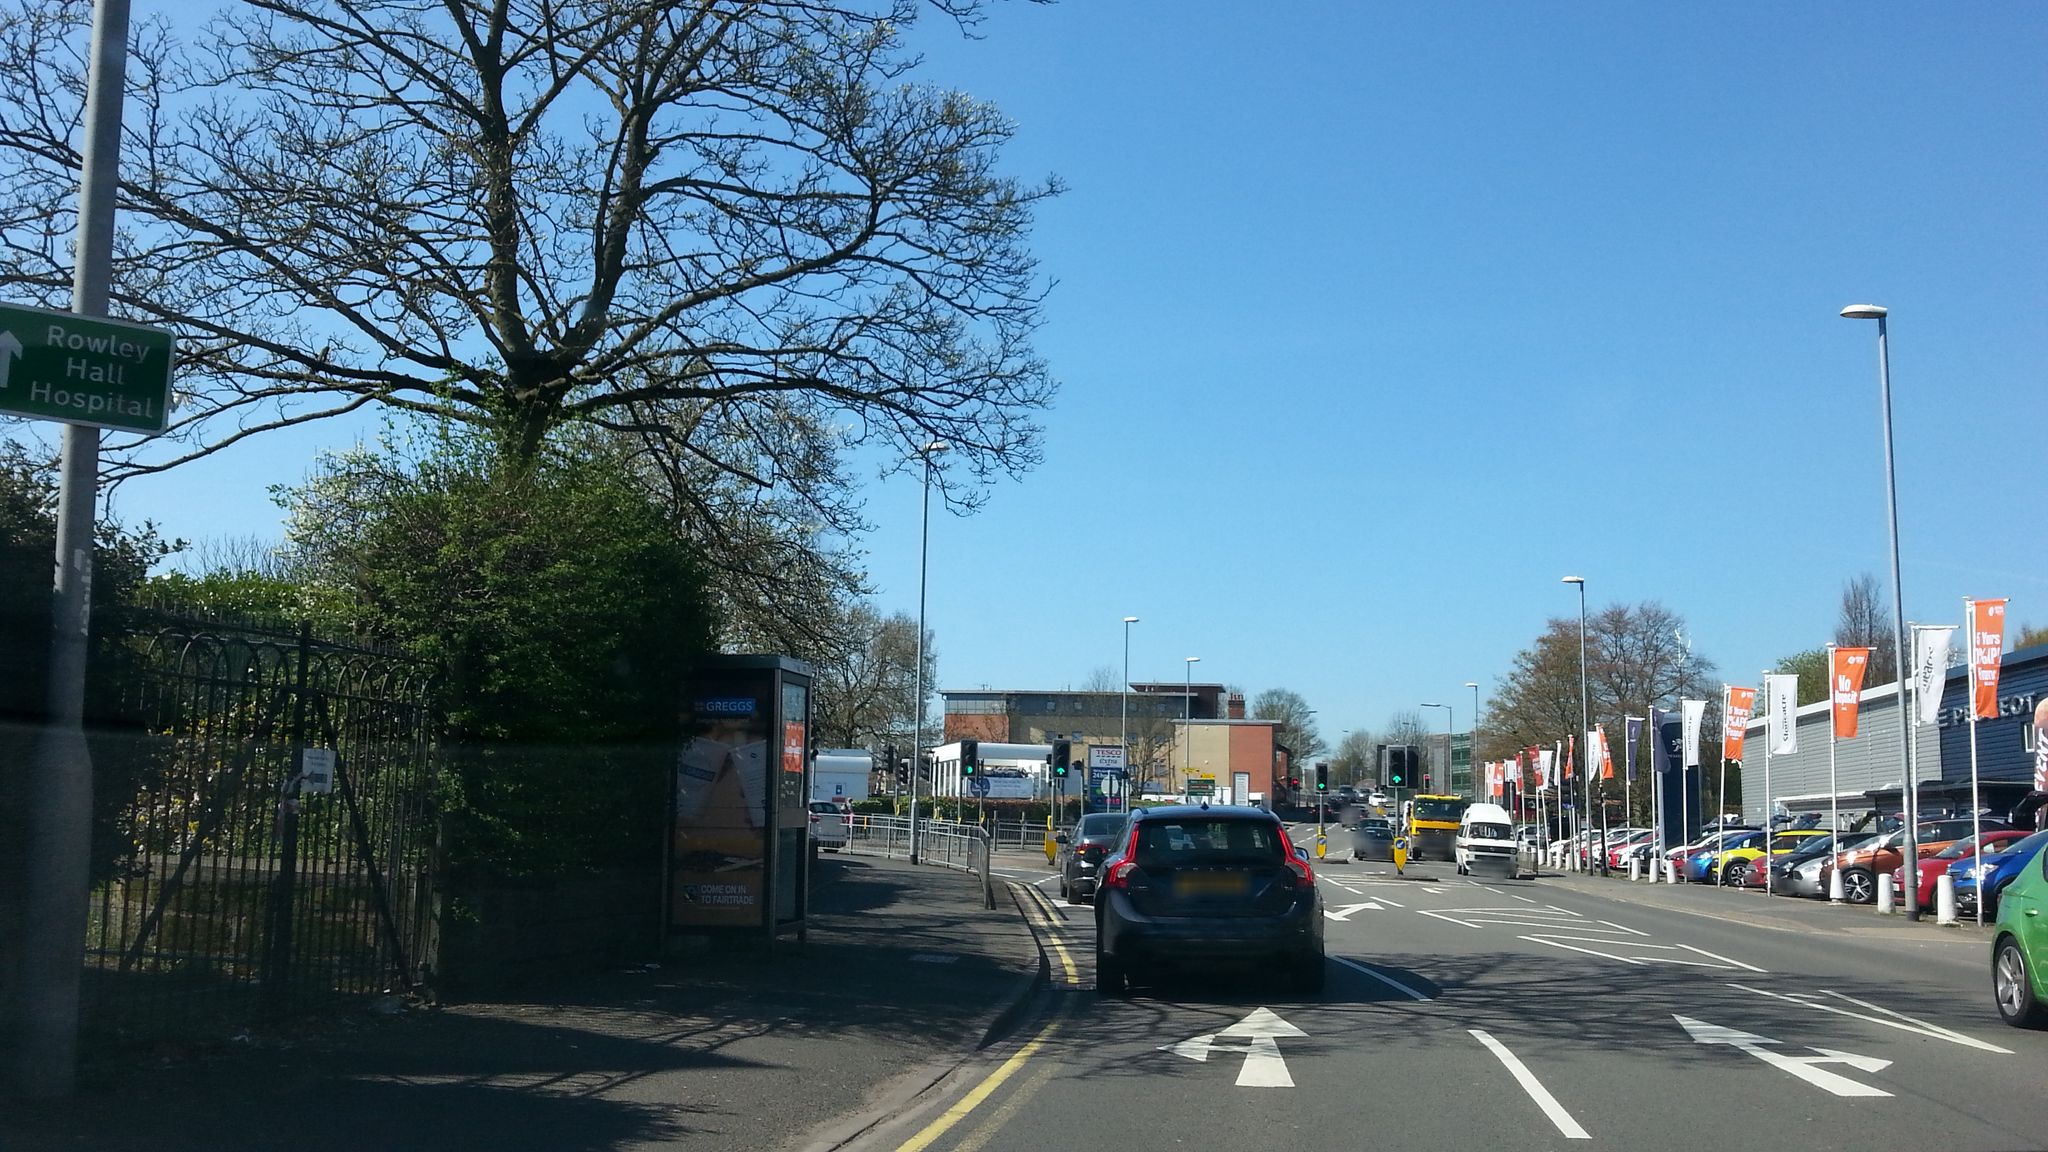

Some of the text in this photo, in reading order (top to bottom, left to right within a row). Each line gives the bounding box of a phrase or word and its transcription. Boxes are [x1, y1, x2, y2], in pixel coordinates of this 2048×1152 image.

[47, 325, 151, 364] Rowley
[66, 357, 125, 386] Hall
[30, 380, 153, 419] Hospital
[1838, 675, 1851, 692] No
[705, 700, 753, 712] GREGGS
[701, 884, 724, 895] COME
[702, 895, 755, 905] TO FAIRTRADE
